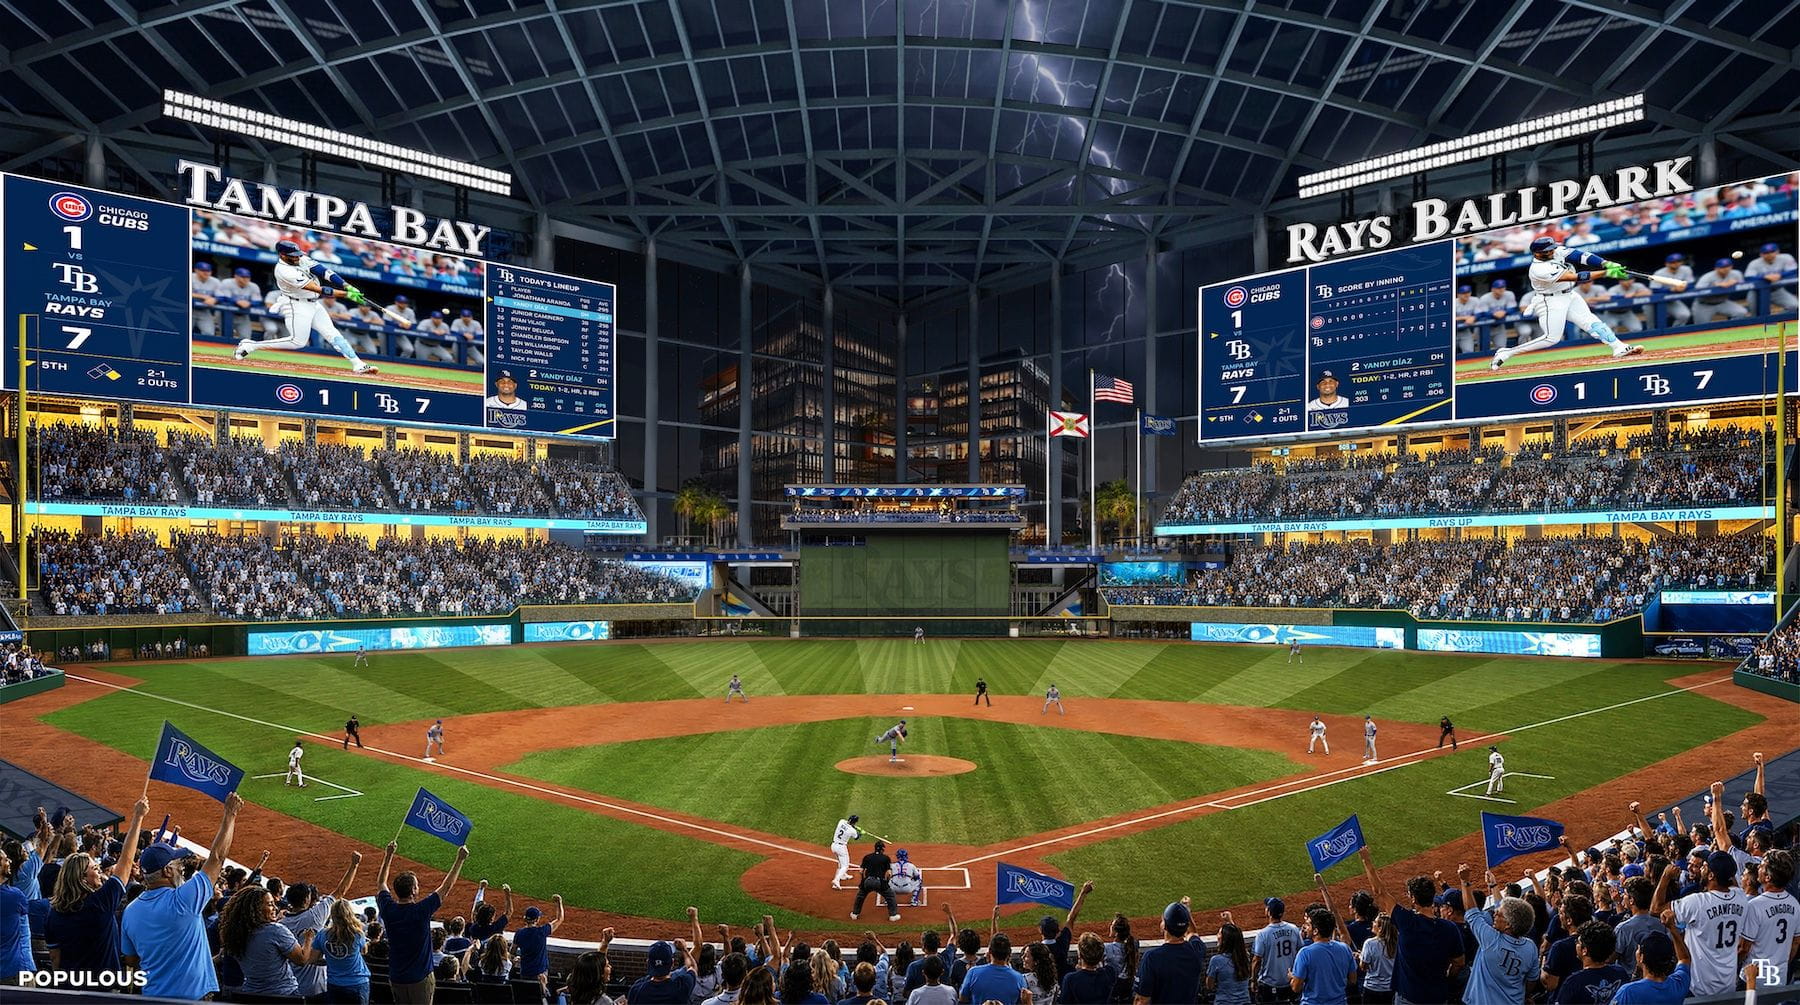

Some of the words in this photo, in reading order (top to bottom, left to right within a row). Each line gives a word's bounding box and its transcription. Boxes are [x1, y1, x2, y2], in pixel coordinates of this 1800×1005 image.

[98, 205, 148, 220] CHICAGO
[178, 159, 381, 237] TAMPA
[391, 205, 490, 256] BAY
[1286, 216, 1392, 264] RAYS
[1412, 156, 1693, 242] BALLPARK
[98, 214, 150, 231] CUBS
[64, 226, 82, 250] 1
[68, 252, 83, 260] VS
[52, 262, 99, 294] TB
[520, 276, 552, 288] TODAY'S
[553, 282, 580, 292] LINEUP
[1338, 283, 1363, 293] SCORE
[1364, 281, 1375, 289] BY
[1376, 276, 1404, 286] INNING
[1250, 284, 1280, 294] CHICAGO
[1250, 290, 1280, 303] CUBS
[1315, 284, 1333, 298] TB
[44, 292, 86, 304] TAMPA
[90, 298, 112, 308] BAY
[512, 293, 545, 302] JONATHAN
[45, 302, 104, 318] RAYS
[1231, 310, 1242, 328] 1
[62, 326, 92, 349] 7
[511, 332, 542, 341] CHANDLER
[524, 341, 561, 351] WILLIAMSON
[1226, 340, 1251, 360] TB
[42, 361, 68, 370] 5TH
[1363, 360, 1390, 369] YANDY
[1392, 358, 1413, 366] DÍAZ
[147, 369, 165, 378] 2-1
[1222, 368, 1254, 380] RAYS
[148, 379, 177, 388] OUTS
[530, 384, 556, 392] TODAY:
[1574, 383, 1585, 400] 1
[1639, 374, 1670, 396] TB
[1693, 370, 1713, 389] 7
[319, 389, 329, 405] 1
[375, 393, 399, 413] TB
[416, 398, 430, 413] 7
[1230, 386, 1246, 404] 7
[101, 506, 137, 515] TAMPA
[140, 507, 159, 516] BAY
[161, 508, 187, 517] RAYS
[290, 512, 321, 520] TAMPA
[340, 514, 363, 522] RAYS
[1606, 513, 1647, 522] TAMPA
[1651, 512, 1674, 521] BAY
[1679, 511, 1712, 520] RAYS
[449, 517, 475, 525] TAMPA
[477, 518, 491, 526] BAY
[492, 518, 512, 526] RAYS
[1303, 522, 1328, 531] RAYS
[1429, 519, 1455, 527] RAYS
[1458, 518, 1473, 526] UP
[165, 736, 231, 786] RAYS
[416, 798, 464, 836] RAYS
[838, 830, 844, 839] 2
[1495, 823, 1551, 851] RAYS
[1315, 829, 1357, 861] RAYS
[1006, 871, 1065, 899] RAYS
[1706, 903, 1744, 920] CRAWFORD
[1766, 904, 1795, 918] LONGORIA
[1716, 920, 1737, 949] 13
[1776, 919, 1788, 944] 3
[1276, 940, 1292, 958] 18
[1500, 948, 1522, 976] TB
